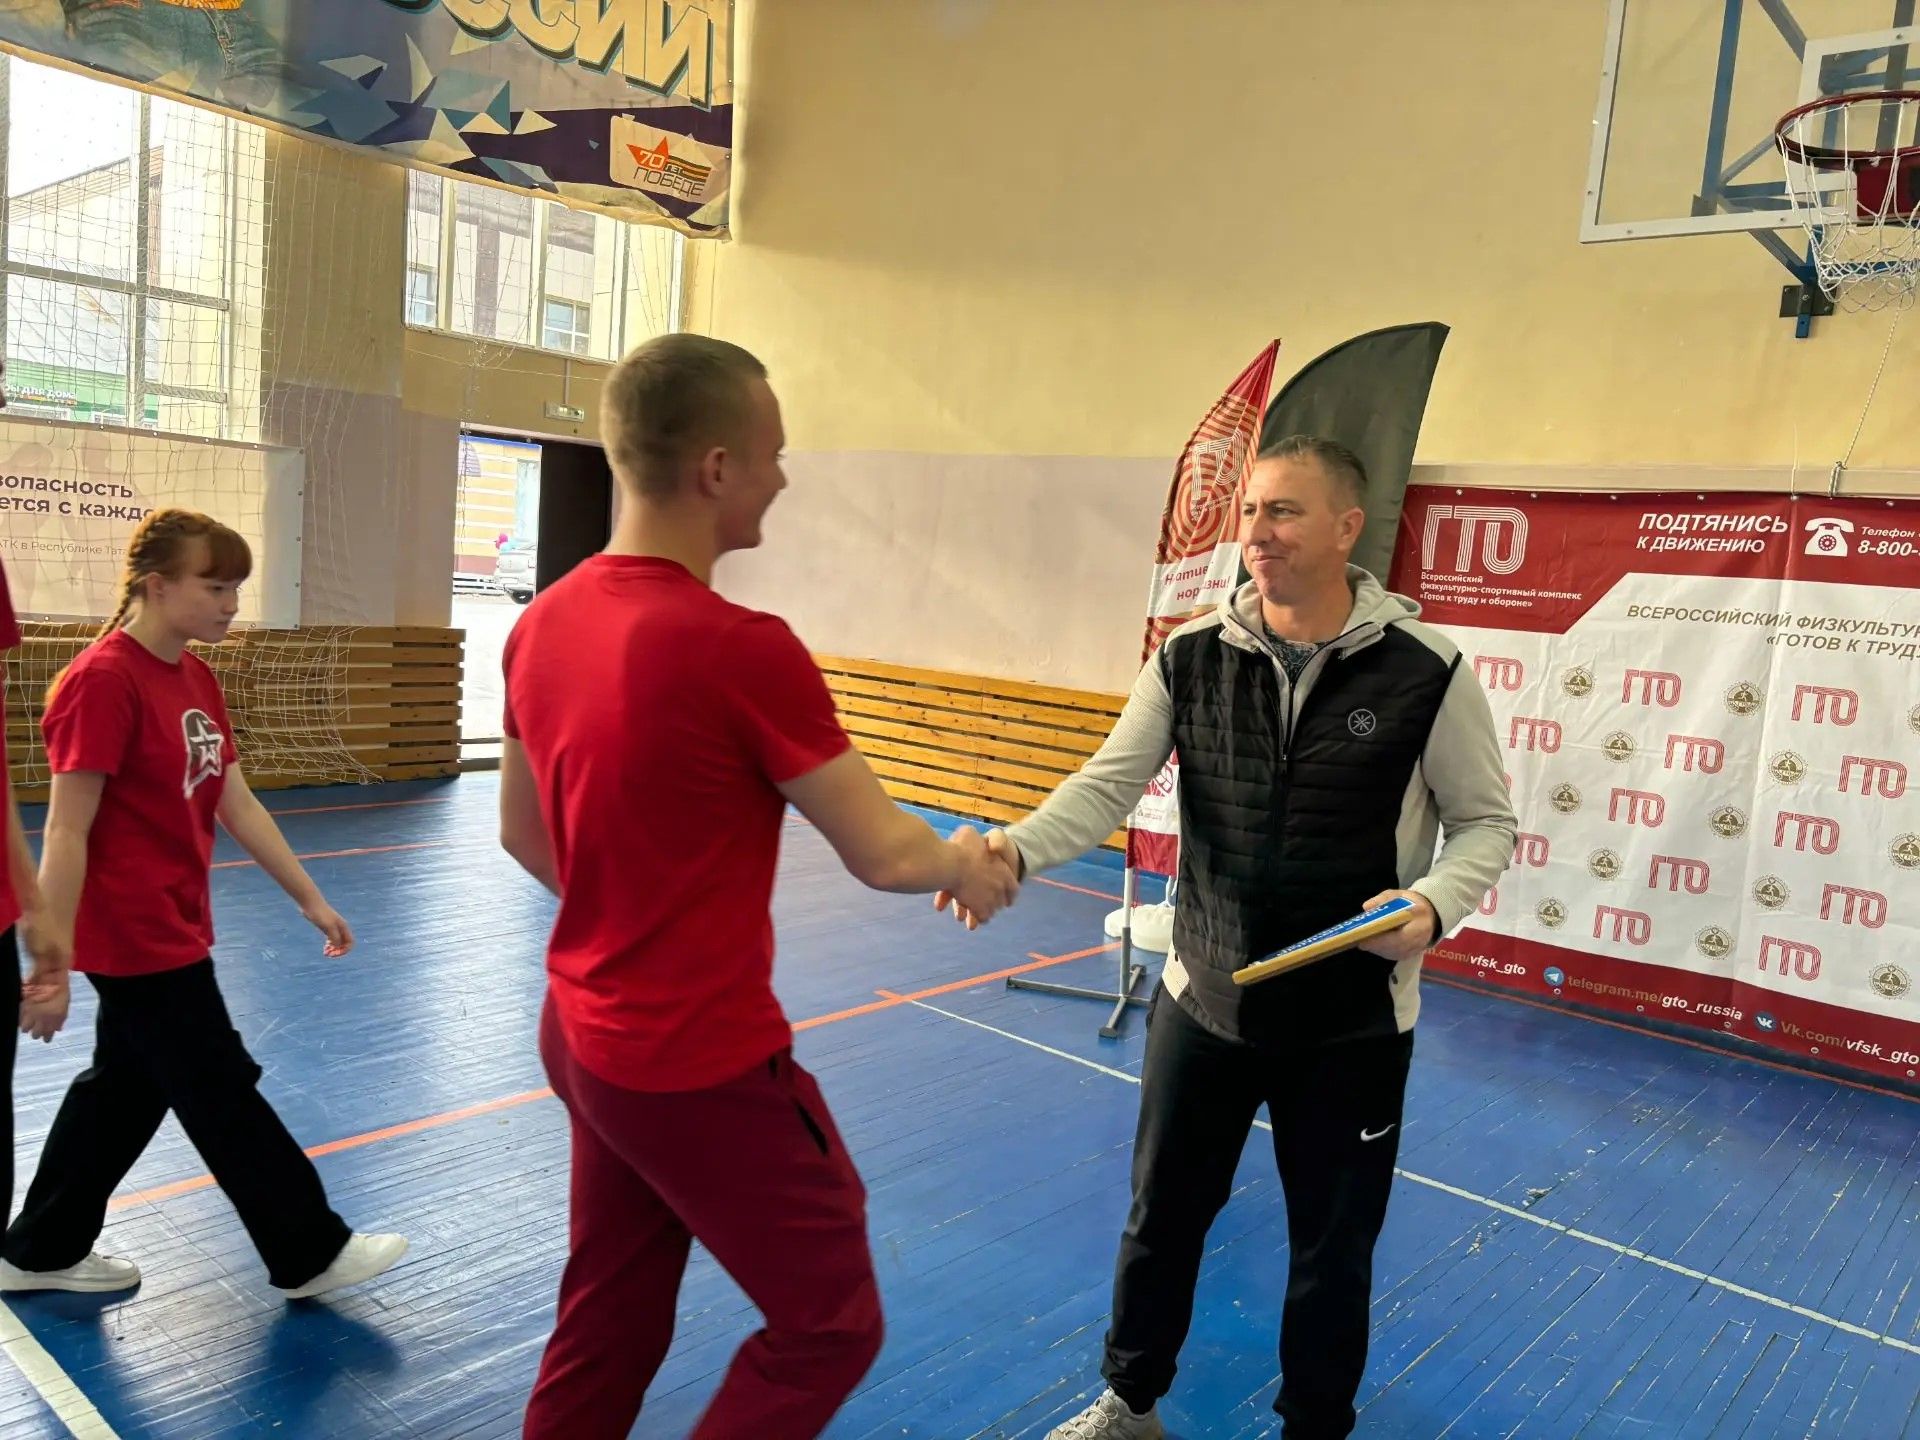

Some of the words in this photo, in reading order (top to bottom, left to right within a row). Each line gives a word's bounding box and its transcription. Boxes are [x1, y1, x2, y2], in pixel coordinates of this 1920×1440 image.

[640, 150, 665, 169] 70
[633, 166, 706, 197] ПОБЕДЕ
[58, 501, 72, 514] с
[1638, 513, 1788, 534] ПОДТЯНИСЬ
[1422, 505, 1528, 575] ГТО
[1636, 536, 1649, 549] К
[1649, 536, 1766, 553] ДВИЖЕНИЮ
[1858, 540, 1920, 557] 8-800-
[1862, 526, 1915, 538] Телефон
[1420, 581, 1536, 598] физкультурно-спортивный
[1538, 590, 1582, 600] комплекс
[1421, 572, 1483, 583] Всероссийский
[1453, 595, 1478, 606] труду
[1488, 598, 1532, 608] обороне»
[1627, 604, 1792, 628] ВСЕРОССИЙСКИЙ
[1766, 633, 1841, 651] «ГОТОВ
[1846, 639, 1860, 652] К
[1474, 655, 1523, 692] ГТО
[1622, 668, 1681, 708] ГТО
[1791, 684, 1858, 727] ГТО
[1509, 716, 1562, 754] ГТО
[1664, 734, 1725, 775] ГТО
[1838, 755, 1907, 799] ГТО
[1608, 787, 1665, 828] ГТО
[1514, 832, 1550, 868] ТО
[1774, 811, 1840, 855] ГТО
[1648, 854, 1710, 895] ГТО
[1820, 883, 1888, 929] ГТО
[1593, 904, 1651, 946] ГТО
[1759, 934, 1822, 981] ГТО
[1568, 975, 1743, 1021] telegram.me/gto_russia
[1780, 1020, 1920, 1065] Vk.com/vfsk_gto
